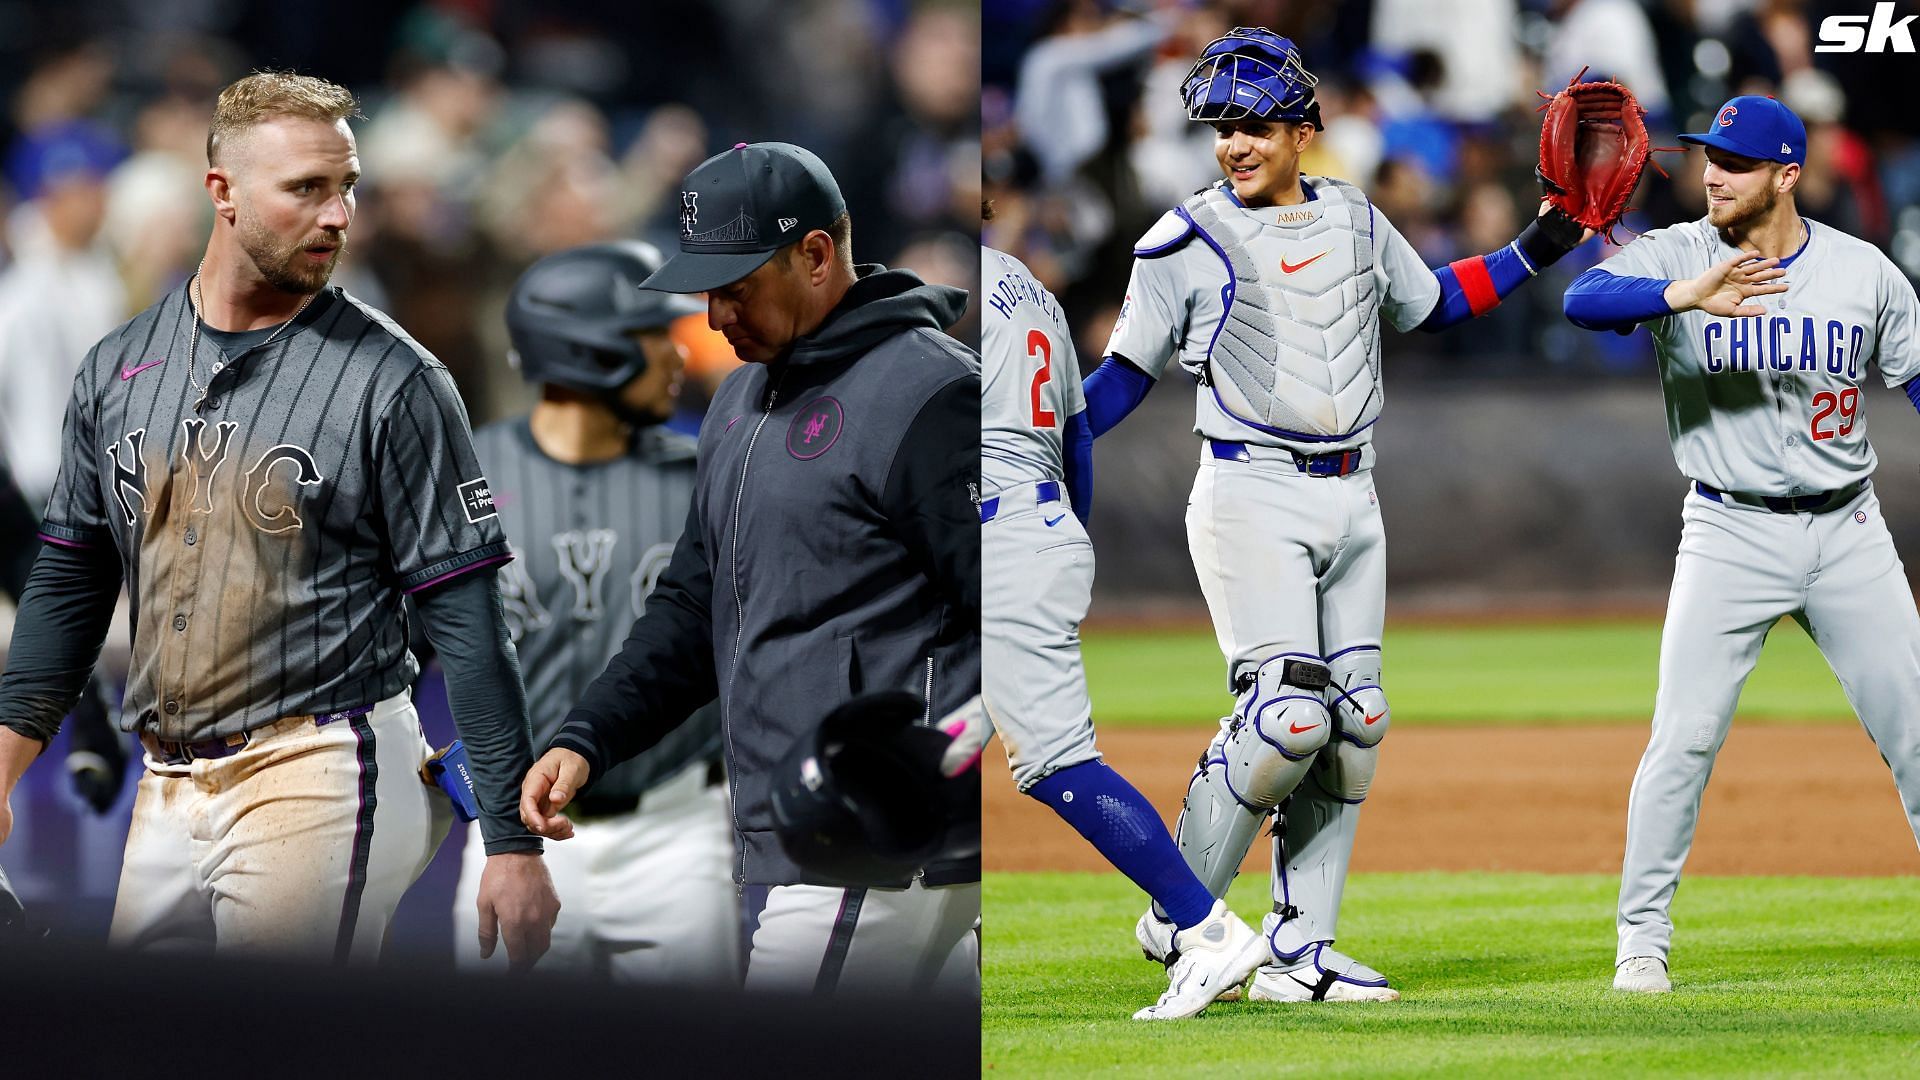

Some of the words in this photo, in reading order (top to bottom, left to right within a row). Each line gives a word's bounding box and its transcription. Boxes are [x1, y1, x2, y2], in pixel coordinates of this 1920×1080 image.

[1719, 106, 1738, 127] C
[1277, 210, 1315, 225] AMAYA
[1704, 315, 1864, 380] CHICAGO
[1026, 328, 1056, 429] 2
[1810, 386, 1859, 442] 29
[105, 418, 324, 535] NYC
